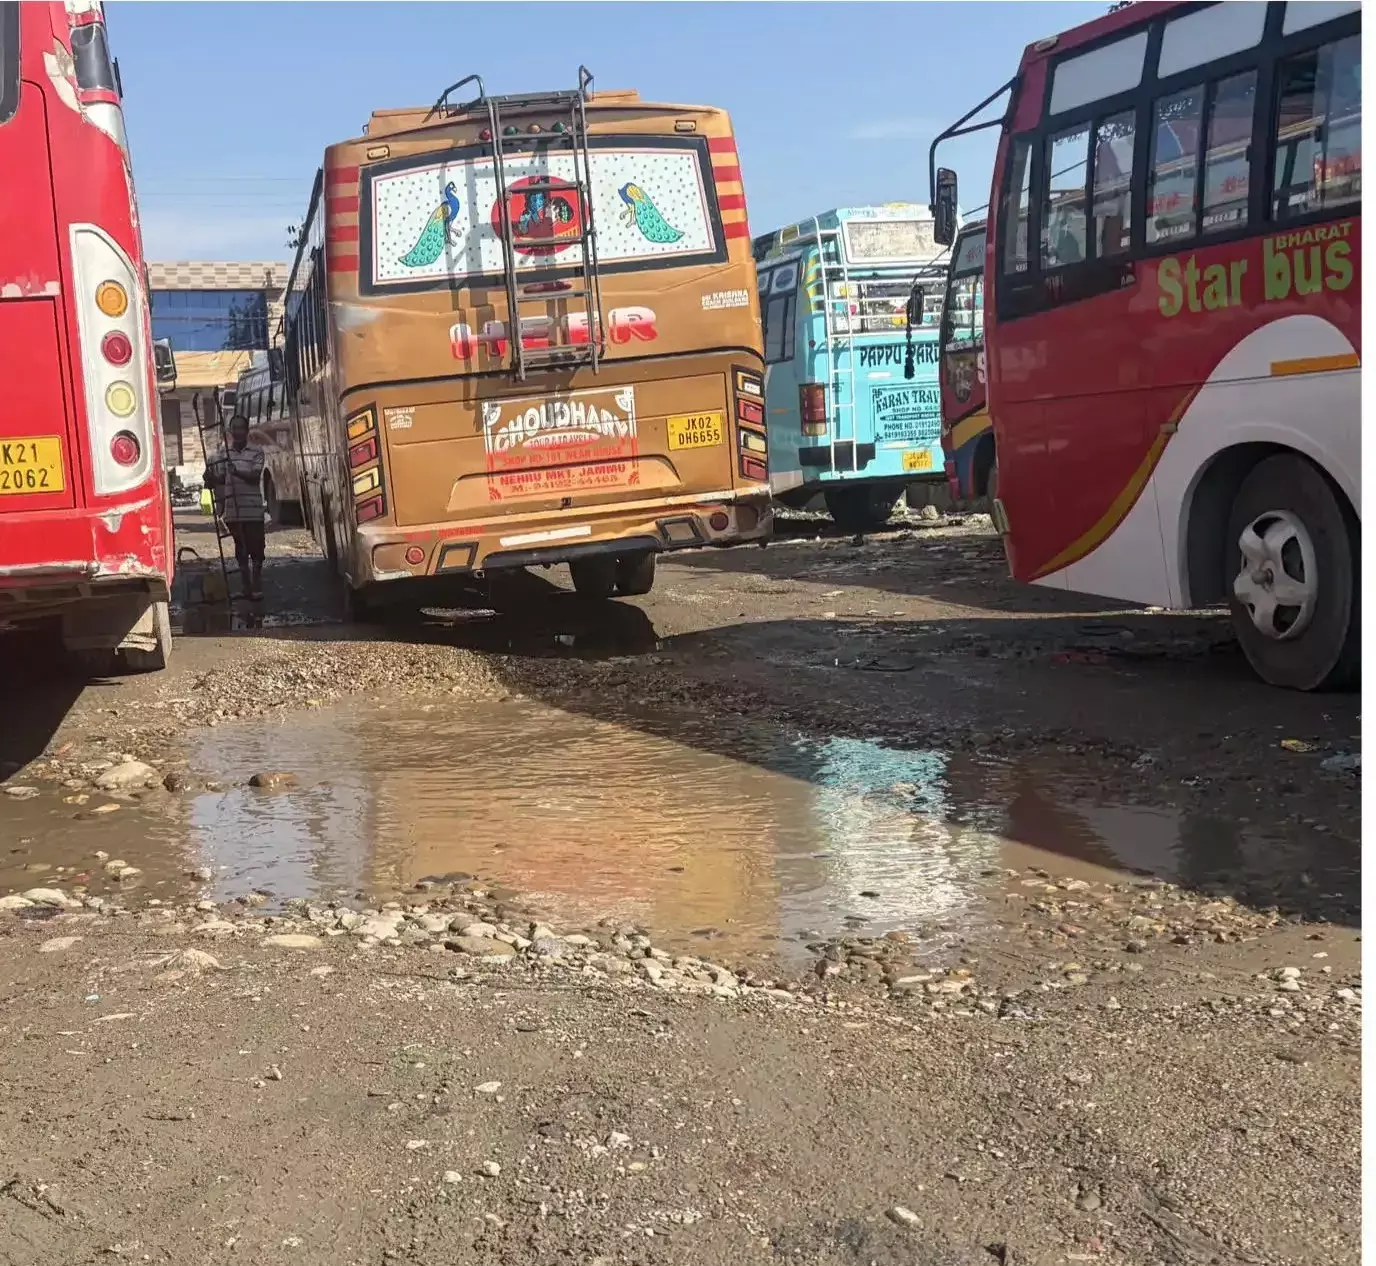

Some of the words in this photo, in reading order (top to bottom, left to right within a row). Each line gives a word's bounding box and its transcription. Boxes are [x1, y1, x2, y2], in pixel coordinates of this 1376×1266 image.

[1275, 222, 1353, 250] BHARAT
[1157, 254, 1248, 317] Star
[1262, 239, 1354, 301] bus
[860, 343, 902, 368] PAPPU
[876, 391, 910, 414] KARAN
[494, 400, 628, 452] CHOUDHARY
[684, 416, 713, 431] JK02
[884, 422, 903, 431] PHONE
[678, 429, 720, 445] DH6655
[2, 444, 38, 465] K21
[0, 468, 49, 490] 2062
[500, 472, 542, 486] NEHRU
[579, 463, 626, 477] JAMMU
